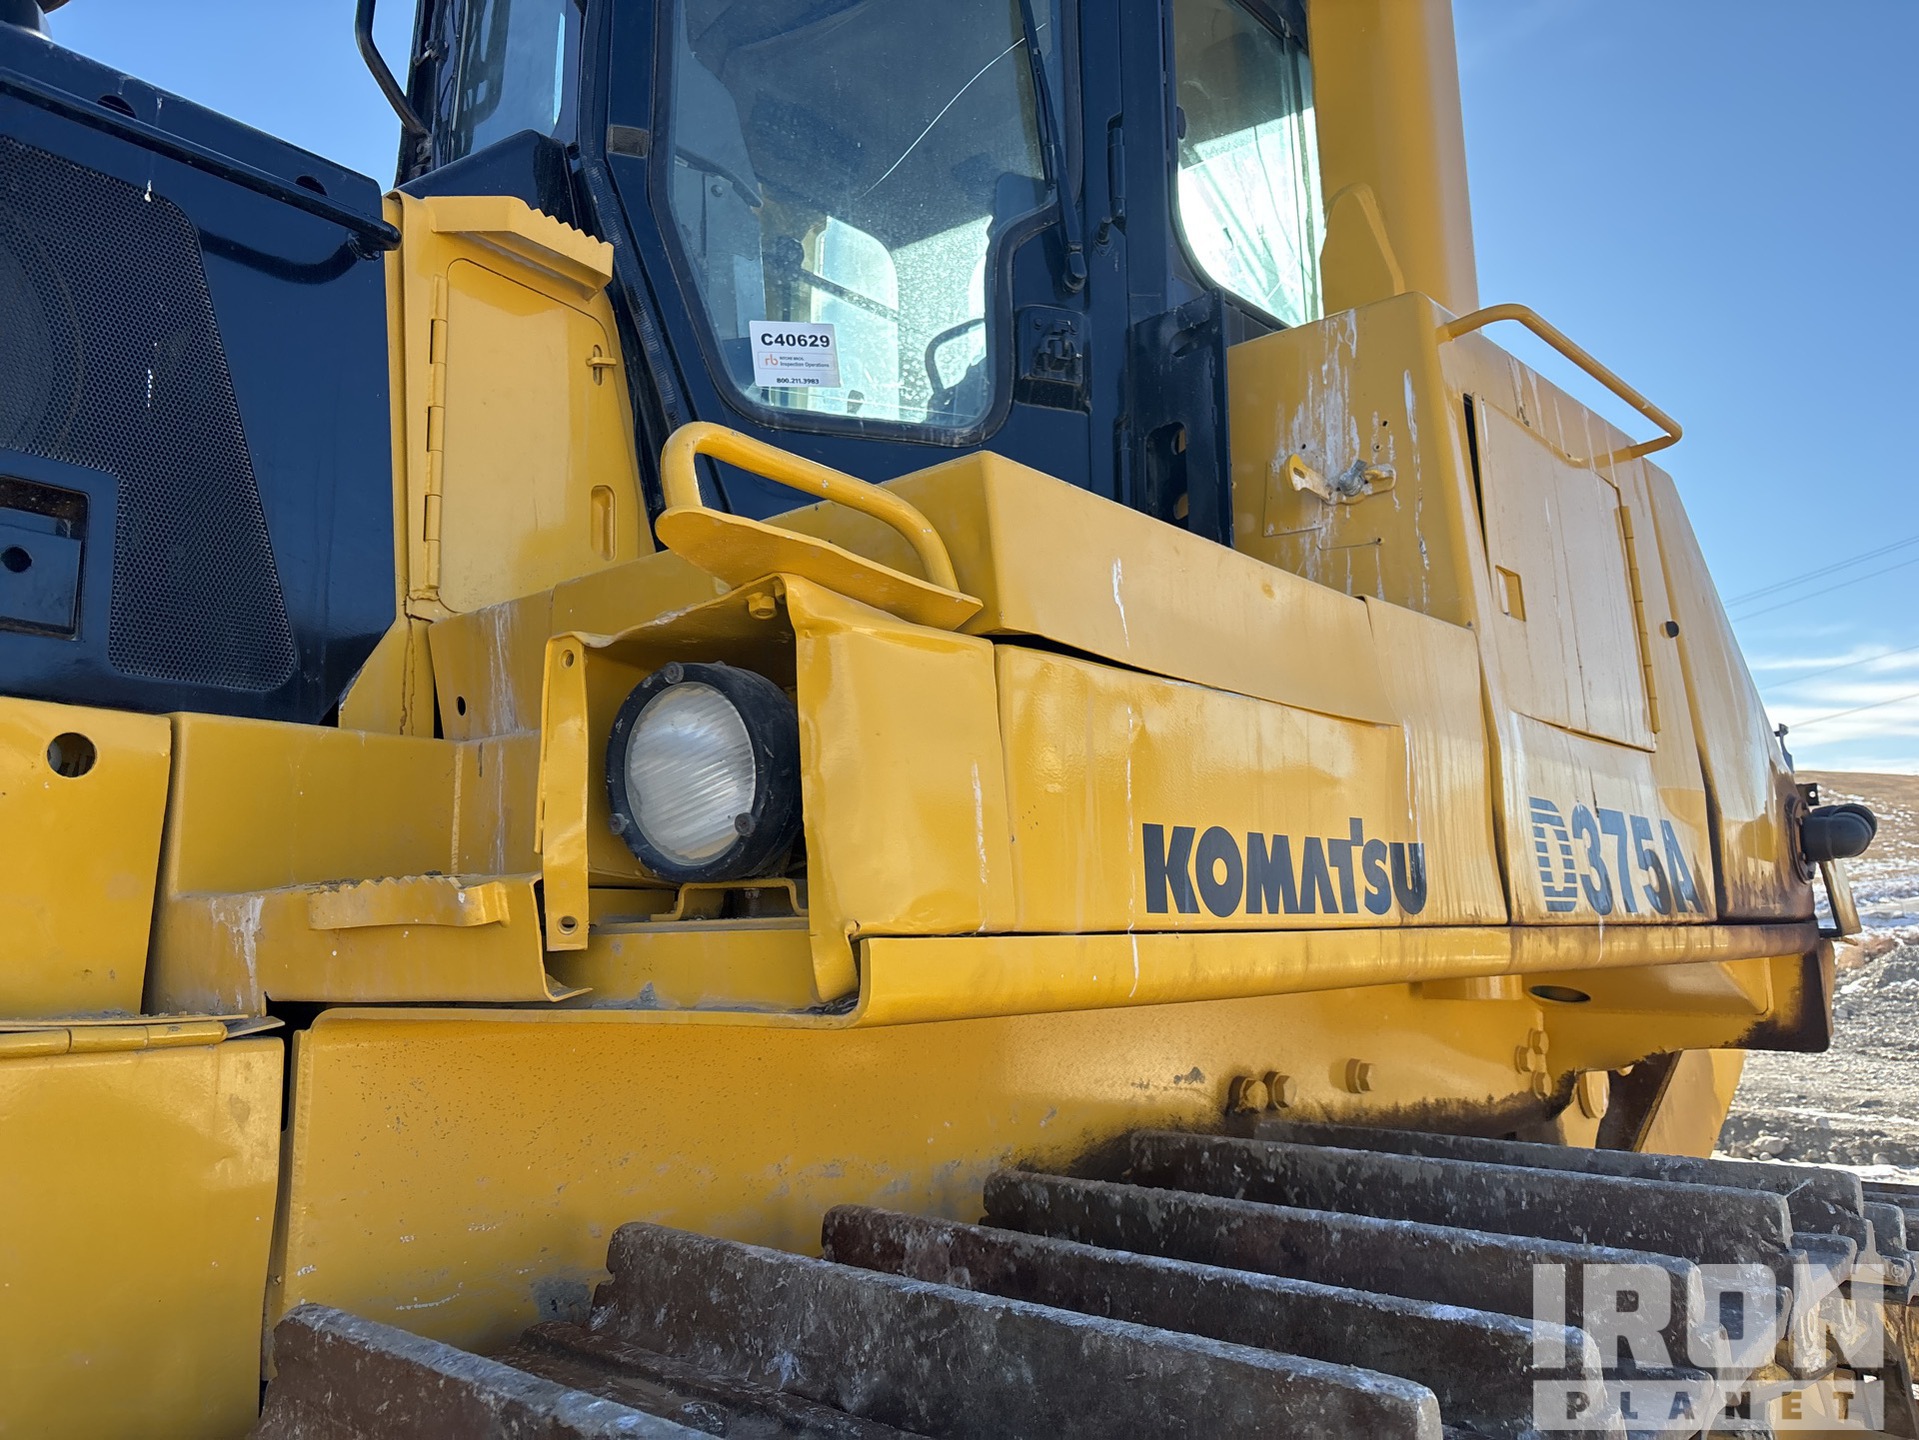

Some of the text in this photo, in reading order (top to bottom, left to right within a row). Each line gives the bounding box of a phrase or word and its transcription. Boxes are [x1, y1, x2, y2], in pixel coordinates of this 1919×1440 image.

[761, 333, 830, 348] C40629
[1143, 817, 1427, 918] KOMATSU
[1529, 796, 1704, 916] D375A
